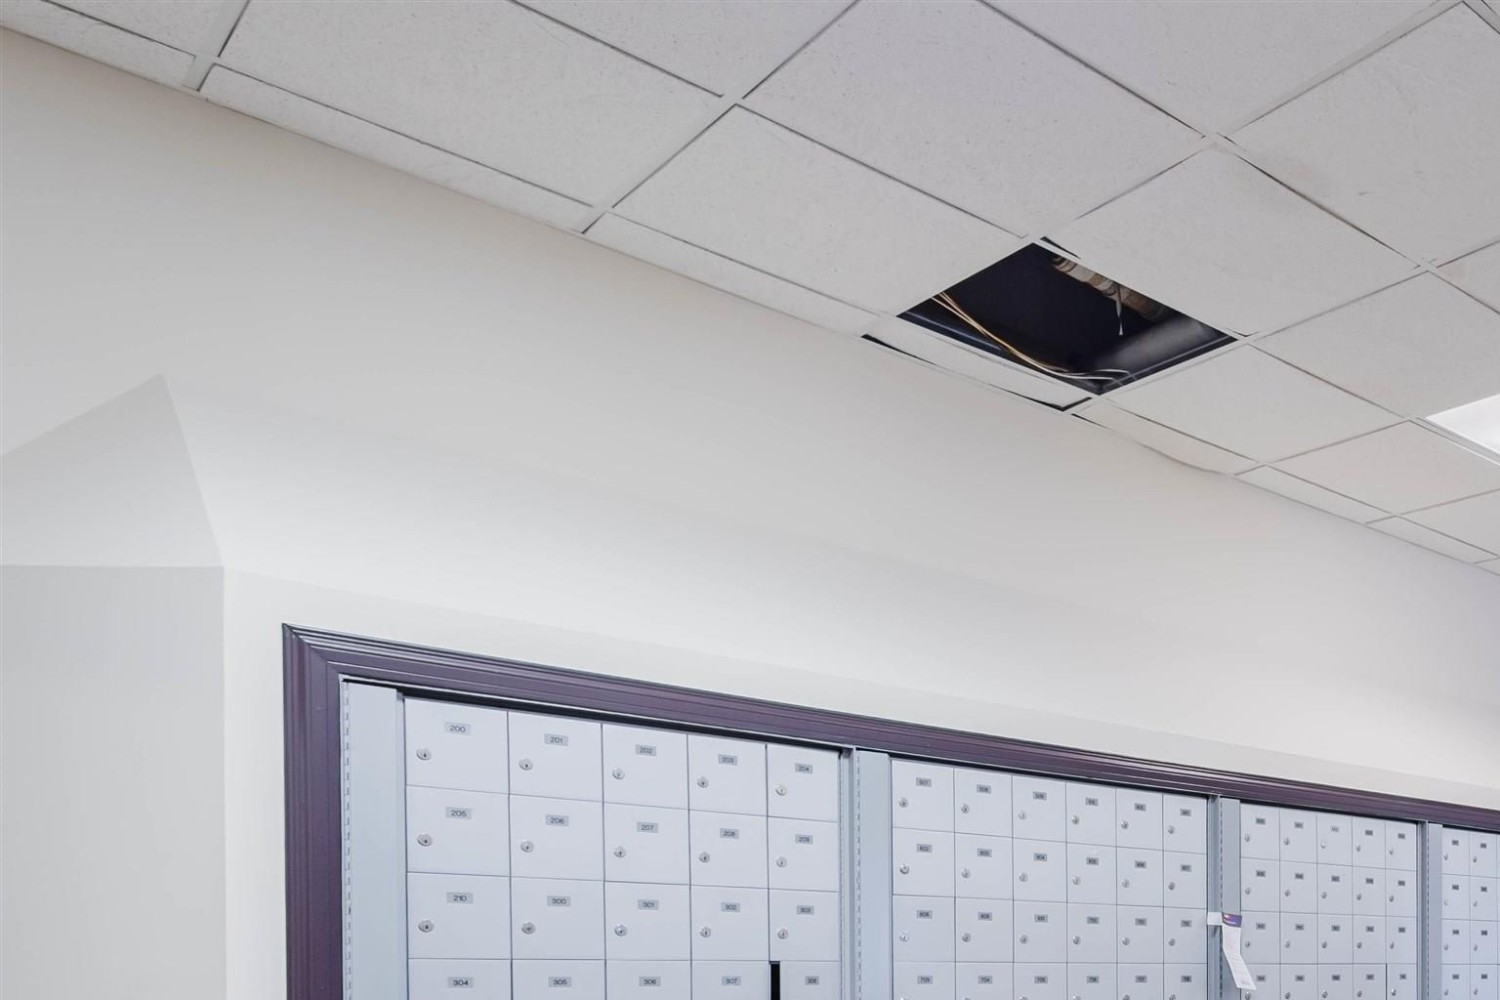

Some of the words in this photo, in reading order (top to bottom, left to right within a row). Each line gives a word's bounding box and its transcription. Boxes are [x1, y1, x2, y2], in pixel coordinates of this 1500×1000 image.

[449, 724, 466, 733] 200
[549, 736, 563, 744] 201
[639, 746, 653, 755] 202
[451, 809, 467, 817] 205
[453, 894, 468, 902] 210
[551, 897, 567, 905] 300
[642, 901, 655, 909] 301
[725, 977, 738, 985] 307
